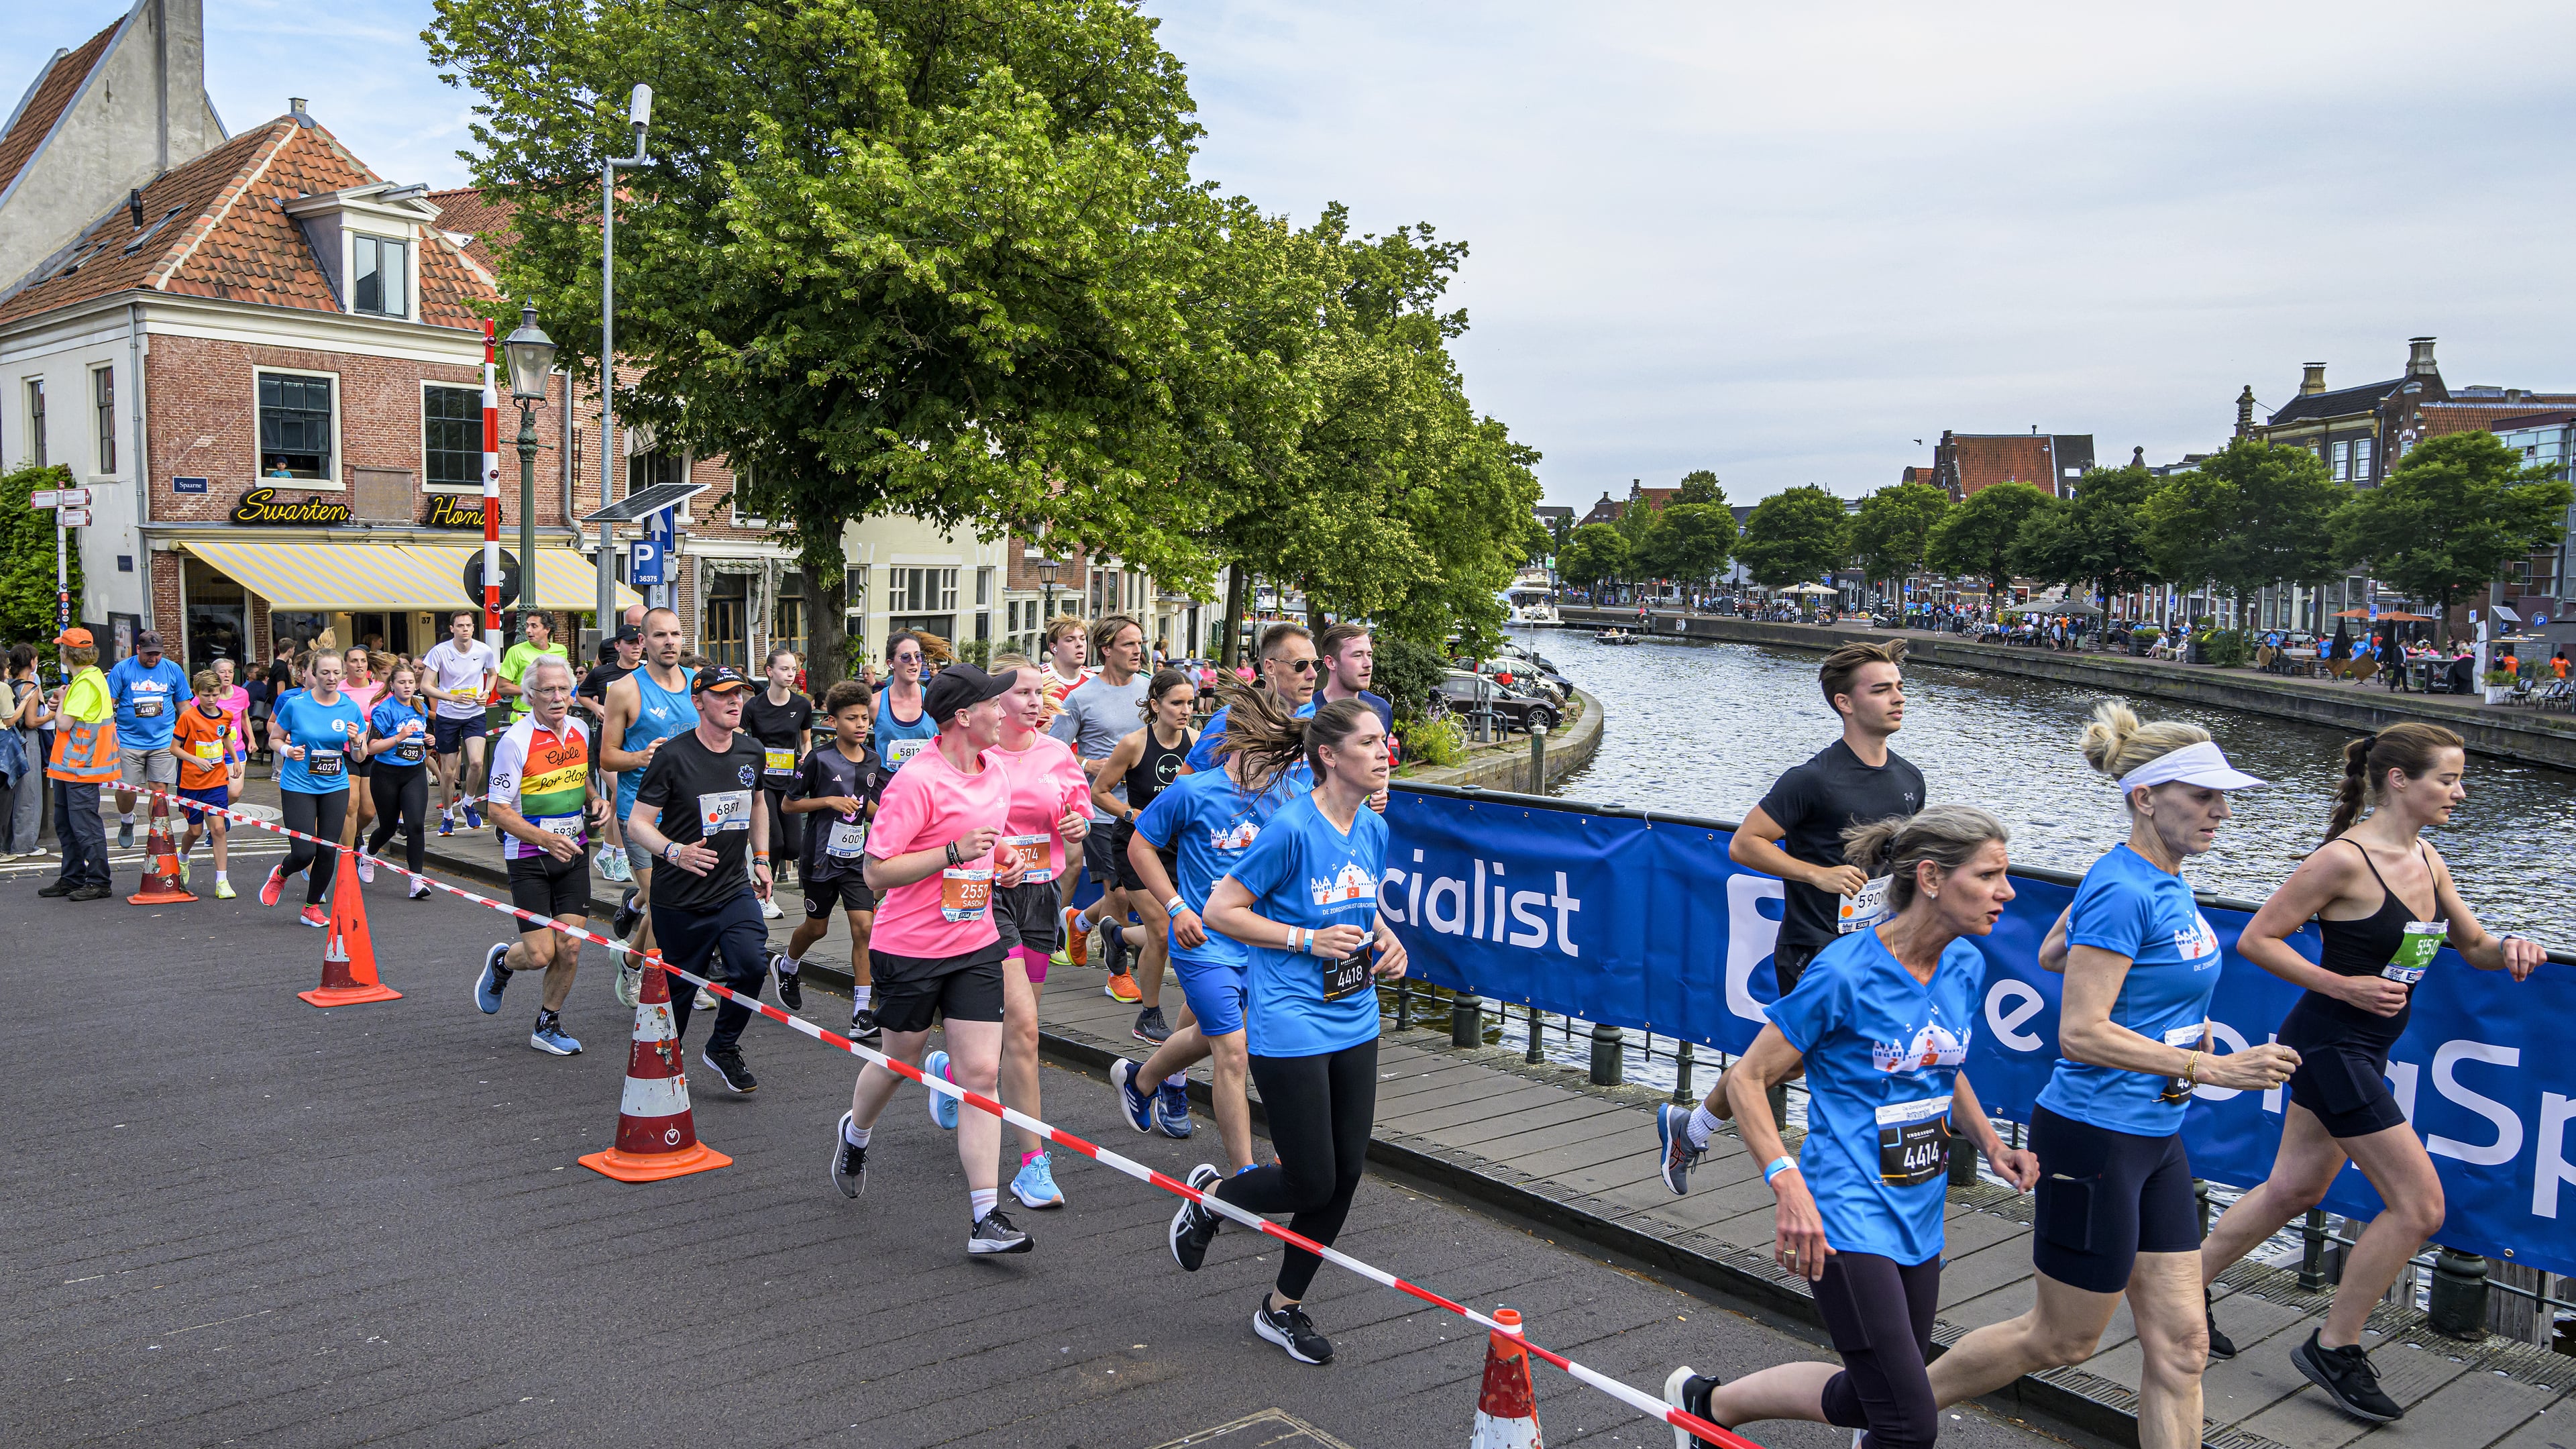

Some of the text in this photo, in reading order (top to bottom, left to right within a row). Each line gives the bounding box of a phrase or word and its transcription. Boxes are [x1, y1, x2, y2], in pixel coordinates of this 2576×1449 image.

[179, 482, 202, 490] Spaarne
[237, 488, 349, 521] Swarten
[634, 544, 655, 570] P
[2537, 617, 2544, 625] P
[693, 678, 702, 690] 19
[402, 749, 419, 757] 4393
[545, 747, 580, 765] Cycle
[317, 763, 336, 771] 4027
[565, 769, 588, 784] Hop
[553, 826, 577, 837] 5938
[842, 834, 863, 844] 6009
[1019, 847, 1038, 861] 574
[961, 883, 989, 899] 2557
[963, 900, 984, 908] SASCHA
[1858, 892, 1881, 908] 590
[2193, 964, 2202, 972] DE
[1337, 965, 1363, 987] 4418
[1984, 978, 2044, 1052] e
[1907, 1128, 1935, 1139] ENDEAVOUR
[1903, 1140, 1939, 1169] 4414
